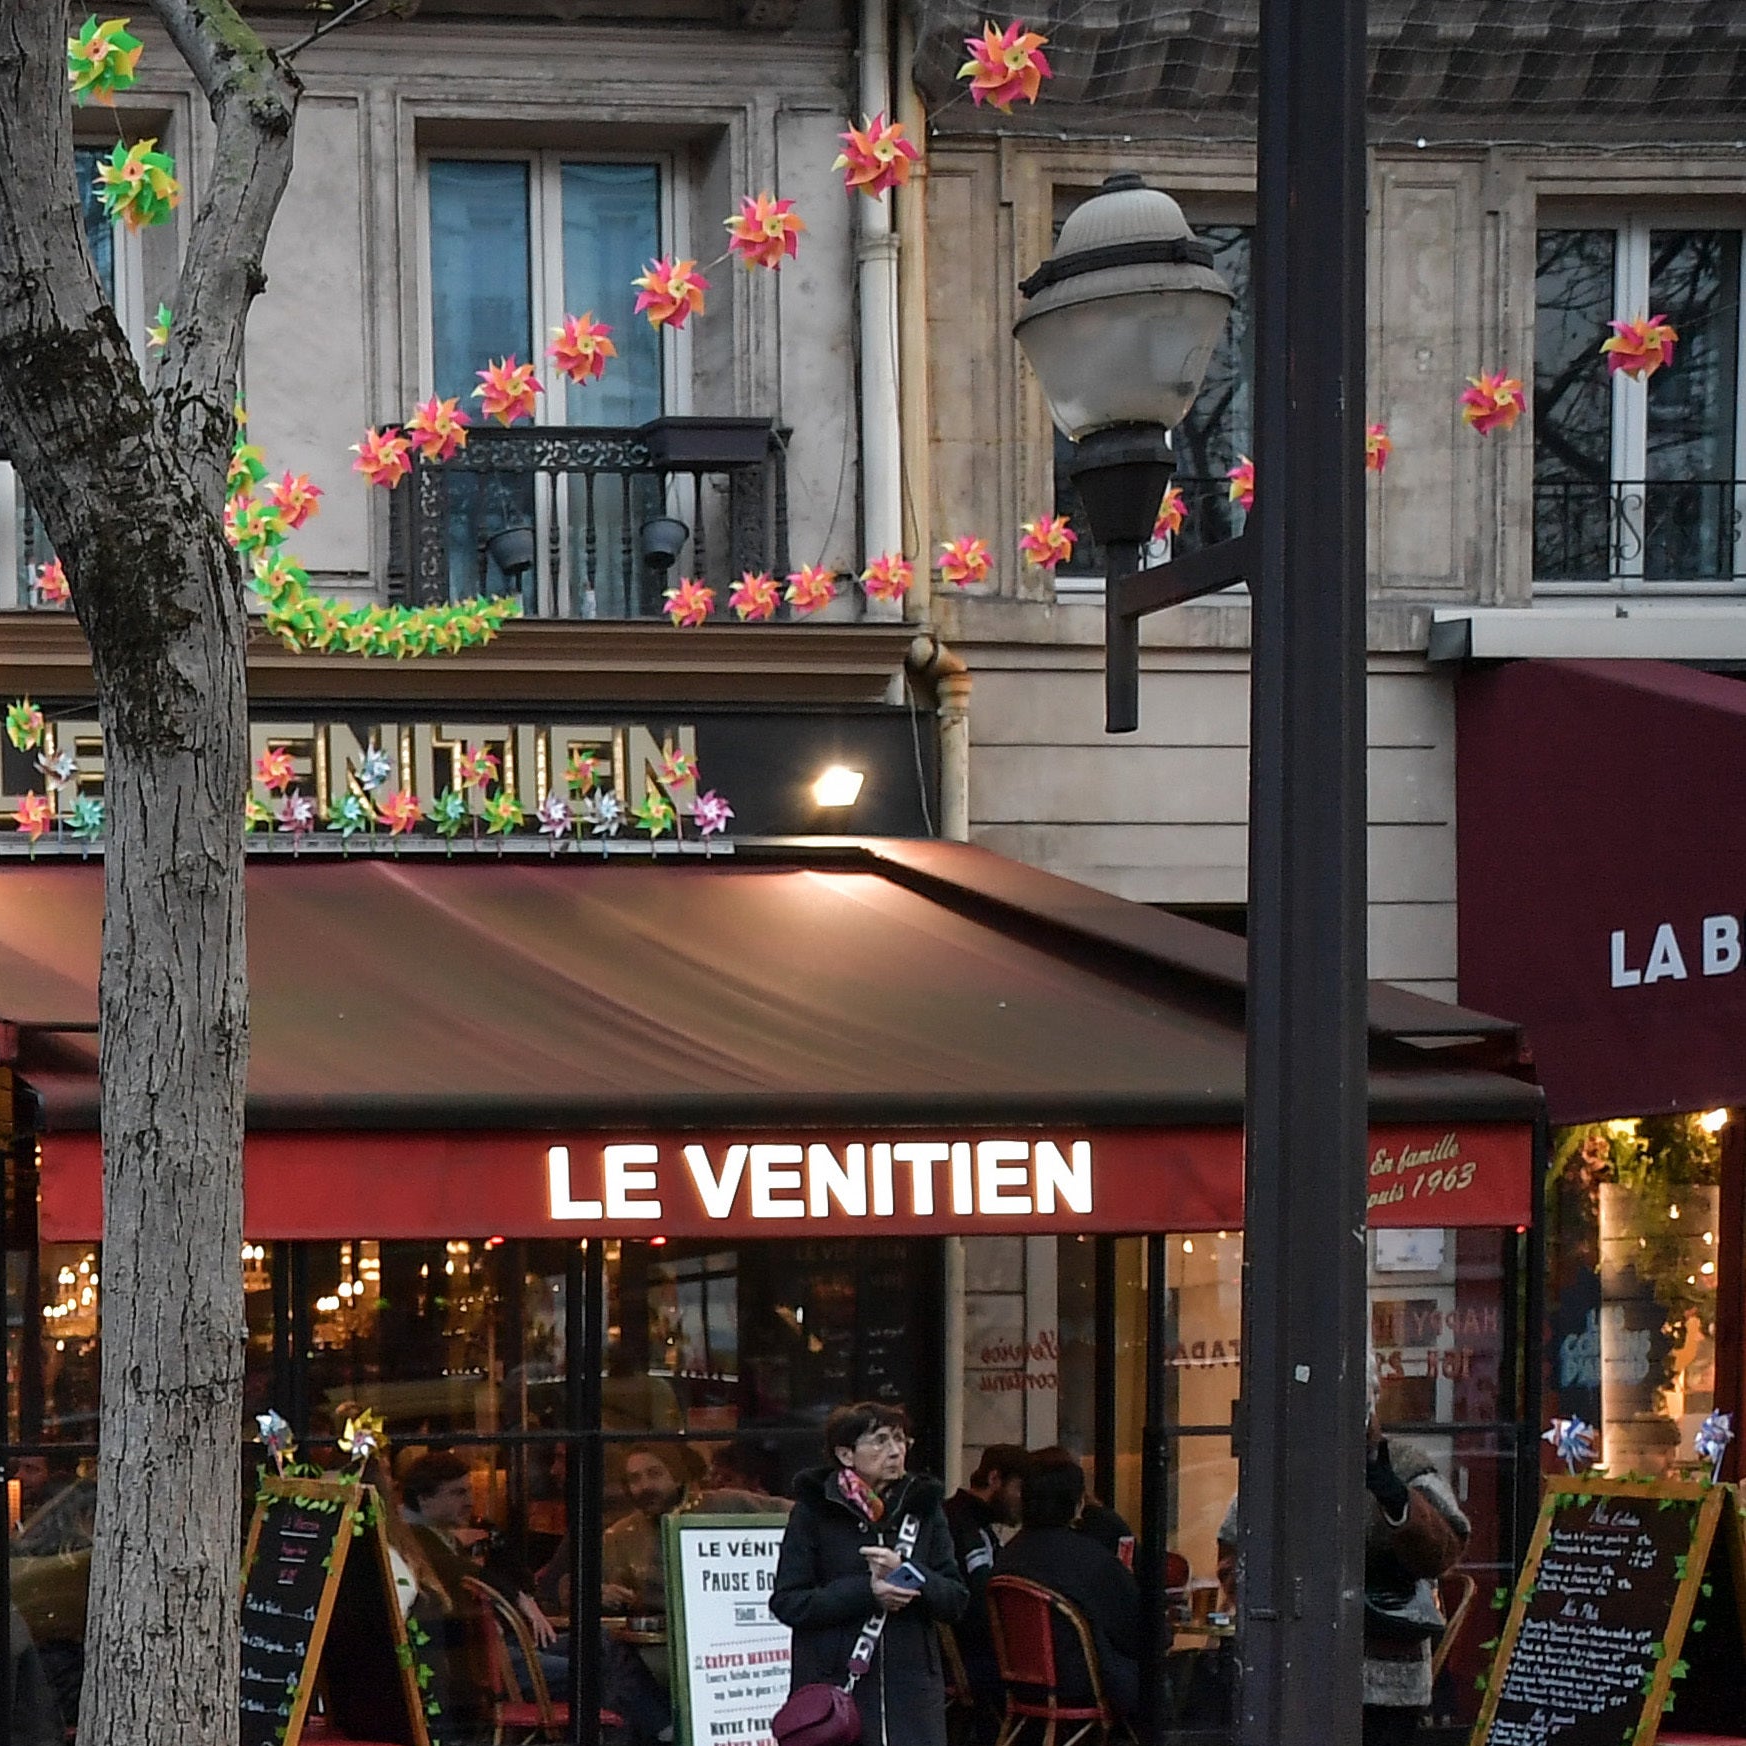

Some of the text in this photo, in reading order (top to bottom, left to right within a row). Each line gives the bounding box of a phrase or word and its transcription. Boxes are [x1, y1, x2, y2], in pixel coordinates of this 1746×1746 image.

[245, 719, 700, 821] ENITIEN
[1611, 929, 1688, 989] LA
[1370, 1131, 1460, 1176] En famille
[547, 1140, 1093, 1220] LE VENITIEN
[1411, 1161, 1477, 1199] 1963
[698, 1541, 721, 1558] LE
[702, 1569, 750, 1592] PAUSE
